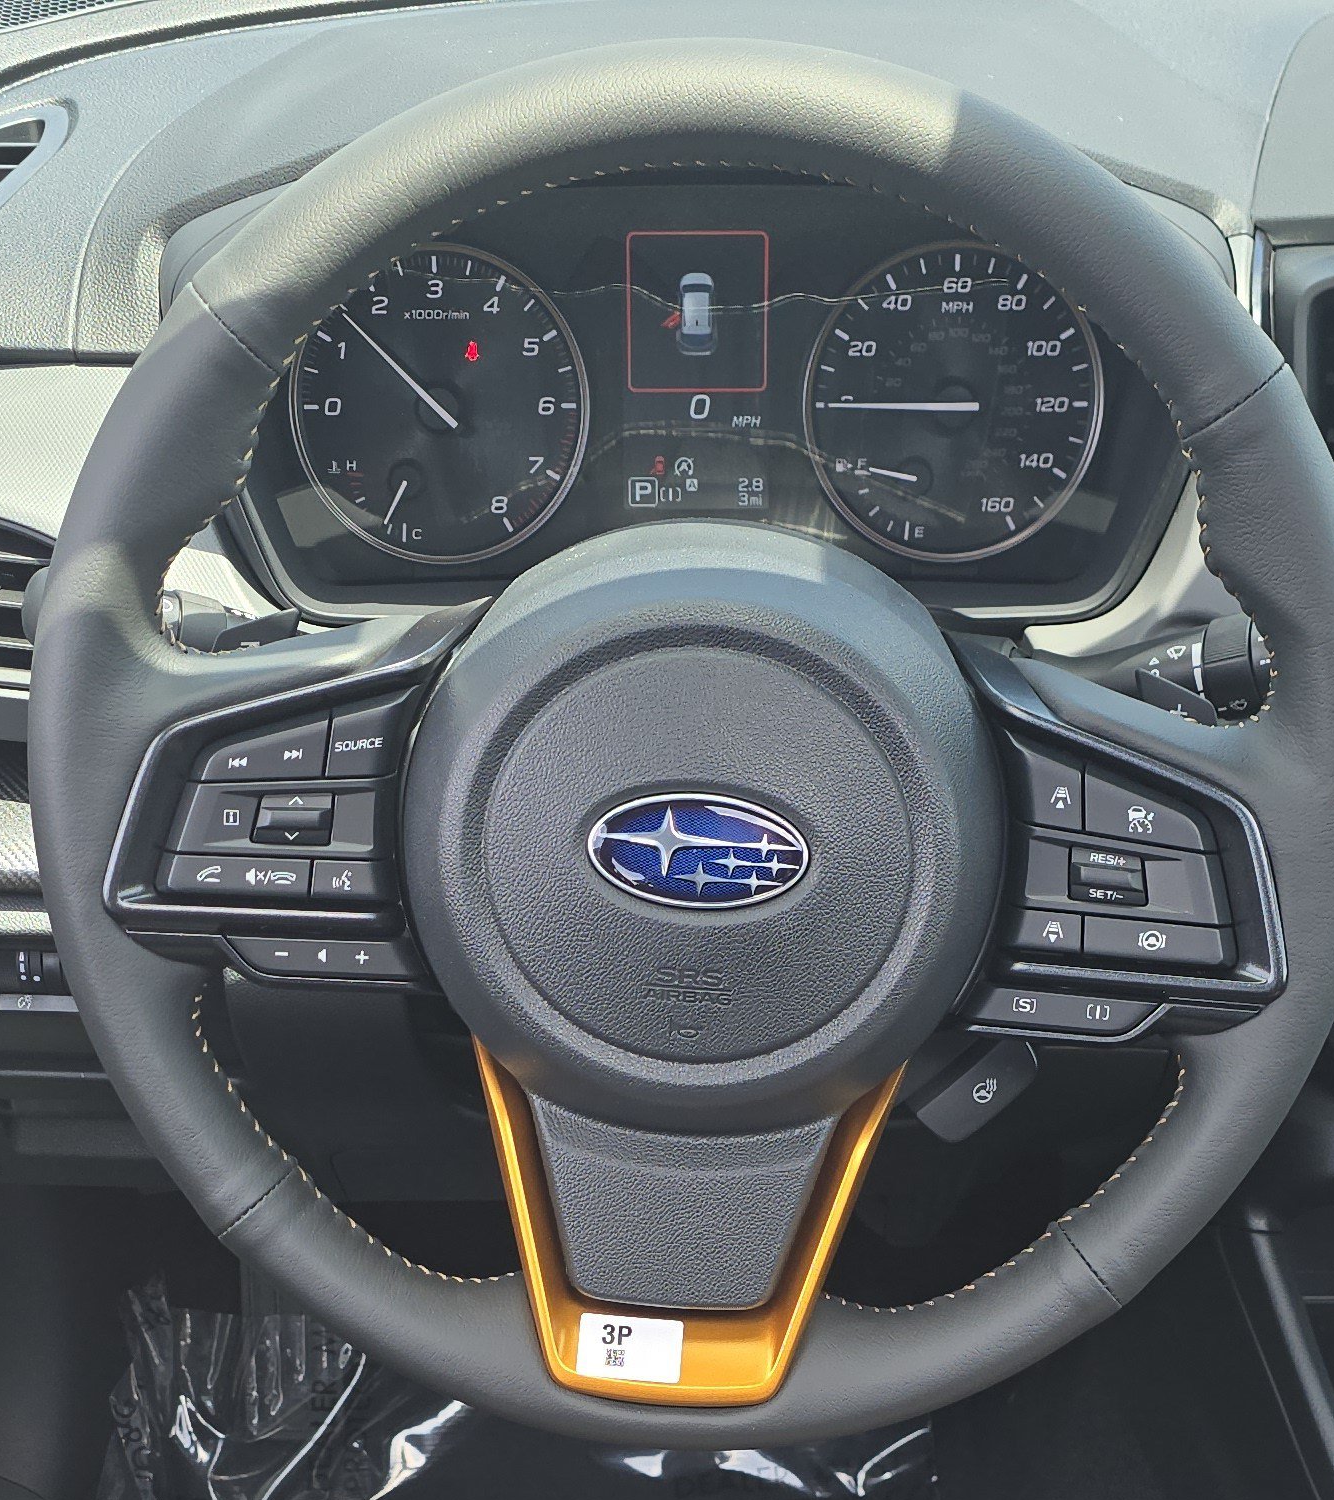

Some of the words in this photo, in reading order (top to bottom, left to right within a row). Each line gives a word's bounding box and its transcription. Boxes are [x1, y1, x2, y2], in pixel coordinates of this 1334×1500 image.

[425, 279, 444, 299] 3
[943, 278, 972, 294] 60
[371, 296, 389, 315] 2
[483, 296, 500, 314] 4
[882, 295, 912, 311] 40
[941, 302, 974, 313] MPH
[997, 295, 1027, 311] 80
[337, 341, 346, 360] 1
[522, 338, 540, 357] 5
[848, 341, 877, 357] 20
[1027, 341, 1061, 357] 100
[324, 397, 342, 416] 0
[538, 396, 555, 416] 6
[690, 394, 710, 419] 0
[731, 416, 761, 428] MPH
[1035, 397, 1069, 413] 120
[347, 460, 356, 471] H
[528, 456, 544, 474] 7
[857, 458, 867, 469] F
[1019, 453, 1054, 469] 140
[635, 482, 652, 502] P
[738, 478, 764, 491] 2.8
[490, 496, 508, 515] 8
[981, 497, 1014, 512] 160
[412, 529, 422, 540] C
[915, 526, 924, 538] E
[334, 737, 384, 753] SOURCE
[655, 968, 723, 987] SRS
[644, 989, 733, 1007] AIRBAG
[601, 1323, 633, 1345] 3P
